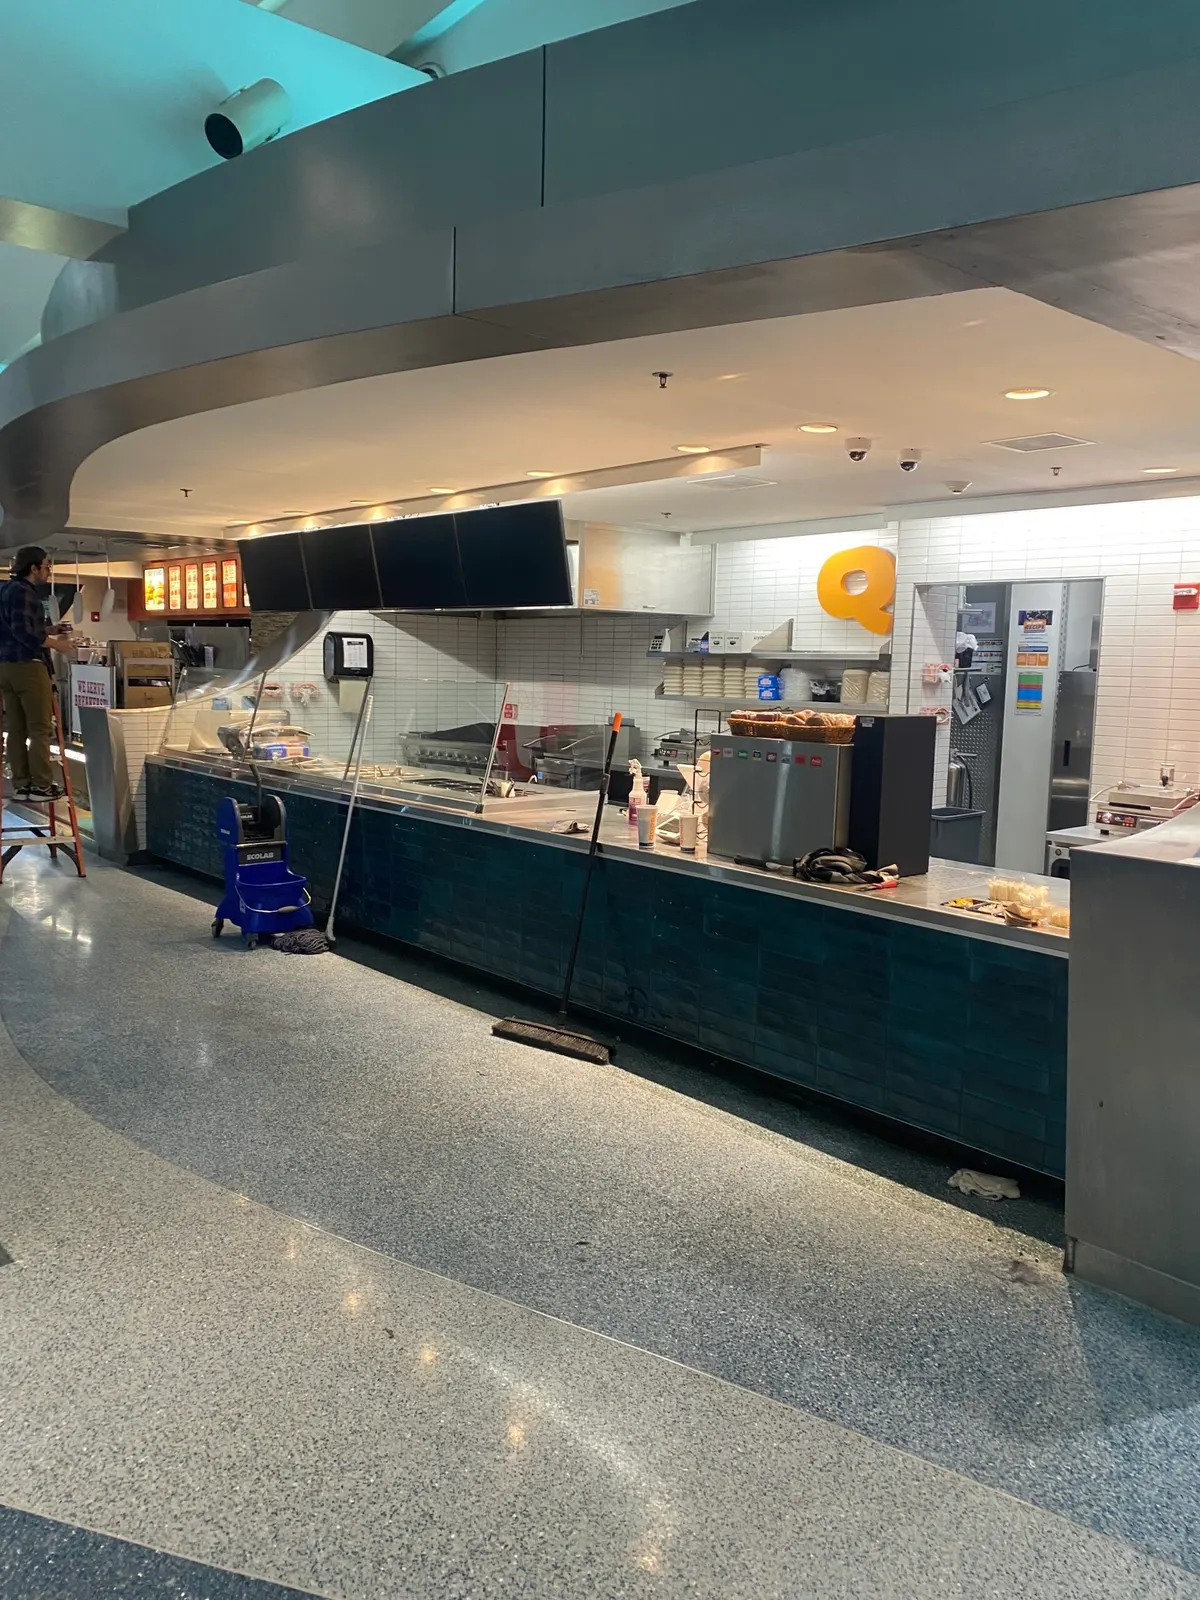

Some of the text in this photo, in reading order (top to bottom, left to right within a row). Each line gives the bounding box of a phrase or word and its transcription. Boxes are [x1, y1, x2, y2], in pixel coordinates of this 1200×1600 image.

[817, 545, 895, 636] Q
[77, 680, 105, 696] WE SERVE
[246, 852, 274, 861] ECOLAB
